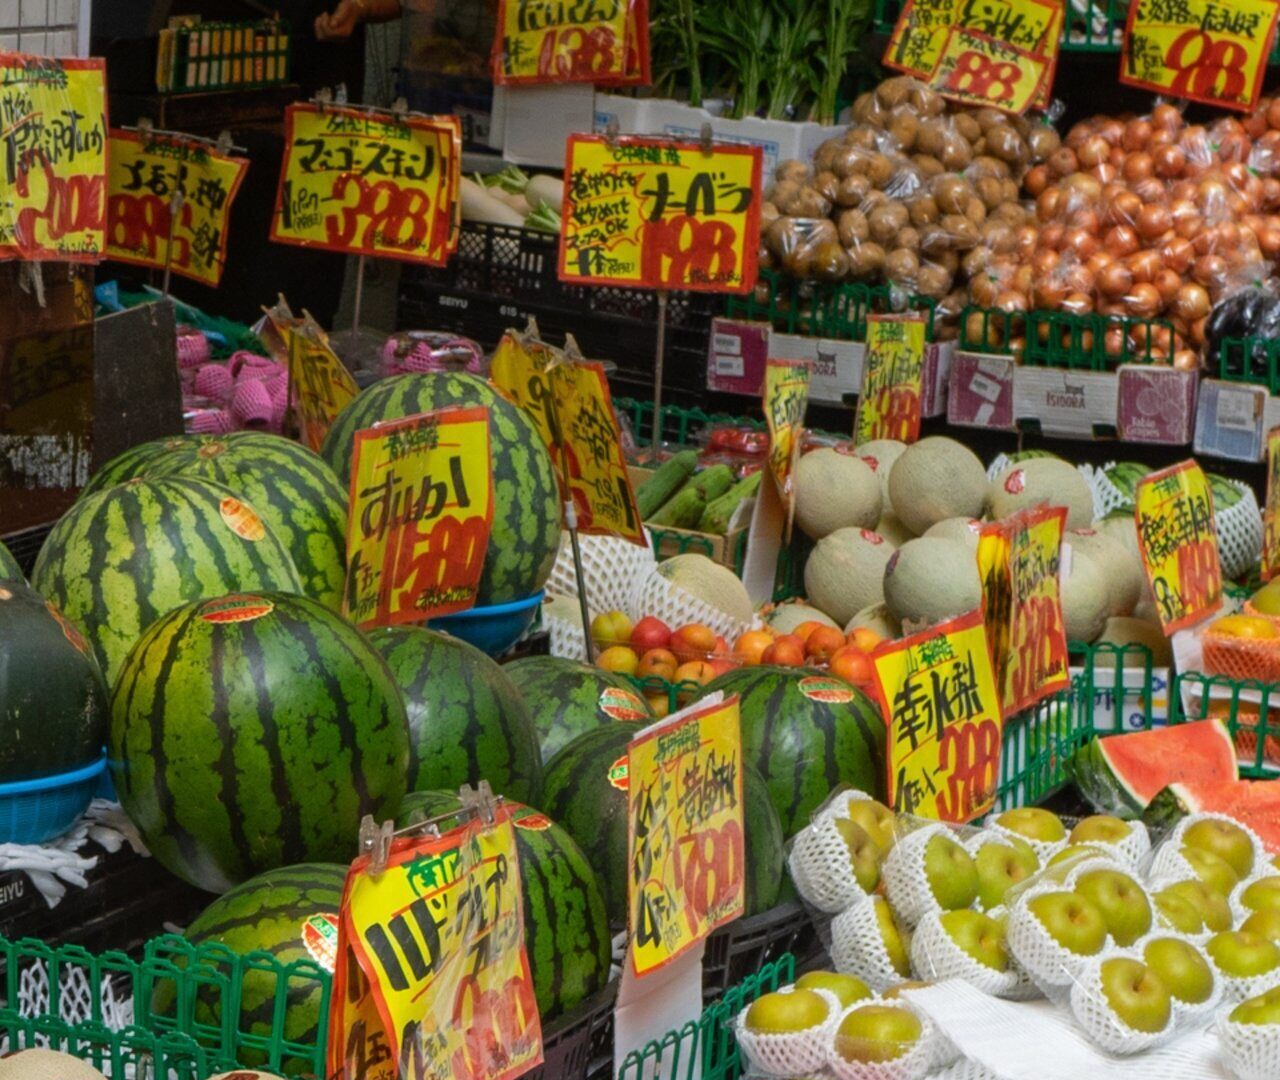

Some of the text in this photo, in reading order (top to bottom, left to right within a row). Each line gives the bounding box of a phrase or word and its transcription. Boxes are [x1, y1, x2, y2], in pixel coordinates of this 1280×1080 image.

[949, 50, 1023, 99] 88
[1165, 28, 1249, 98] 98
[325, 173, 431, 251] 398
[1045, 391, 1087, 411] ISIDORA
[360, 455, 471, 543] すいか
[893, 648, 985, 752] 幸水梨
